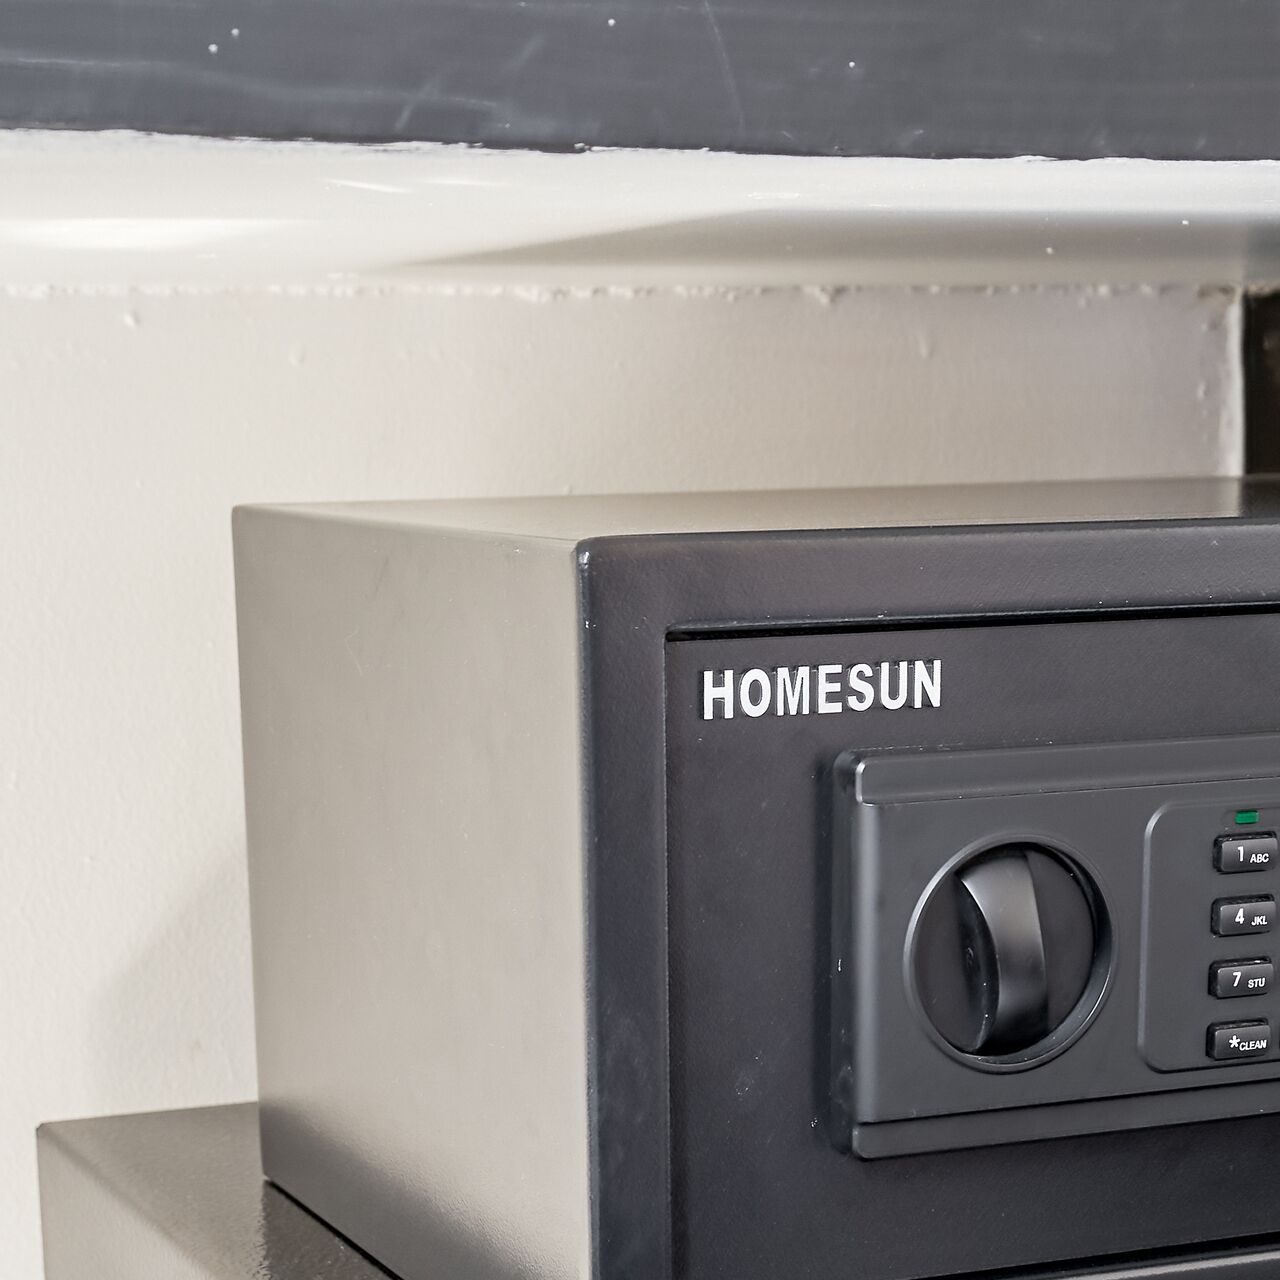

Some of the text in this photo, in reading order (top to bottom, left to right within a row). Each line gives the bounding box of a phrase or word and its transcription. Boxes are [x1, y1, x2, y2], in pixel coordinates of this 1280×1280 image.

[703, 660, 941, 720] HOMESUN
[1237, 846, 1270, 863] 1 ABC
[1234, 908, 1268, 925] 4 JKL
[1232, 972, 1266, 988] 7 STU
[1239, 1039, 1267, 1051] CLEAN
